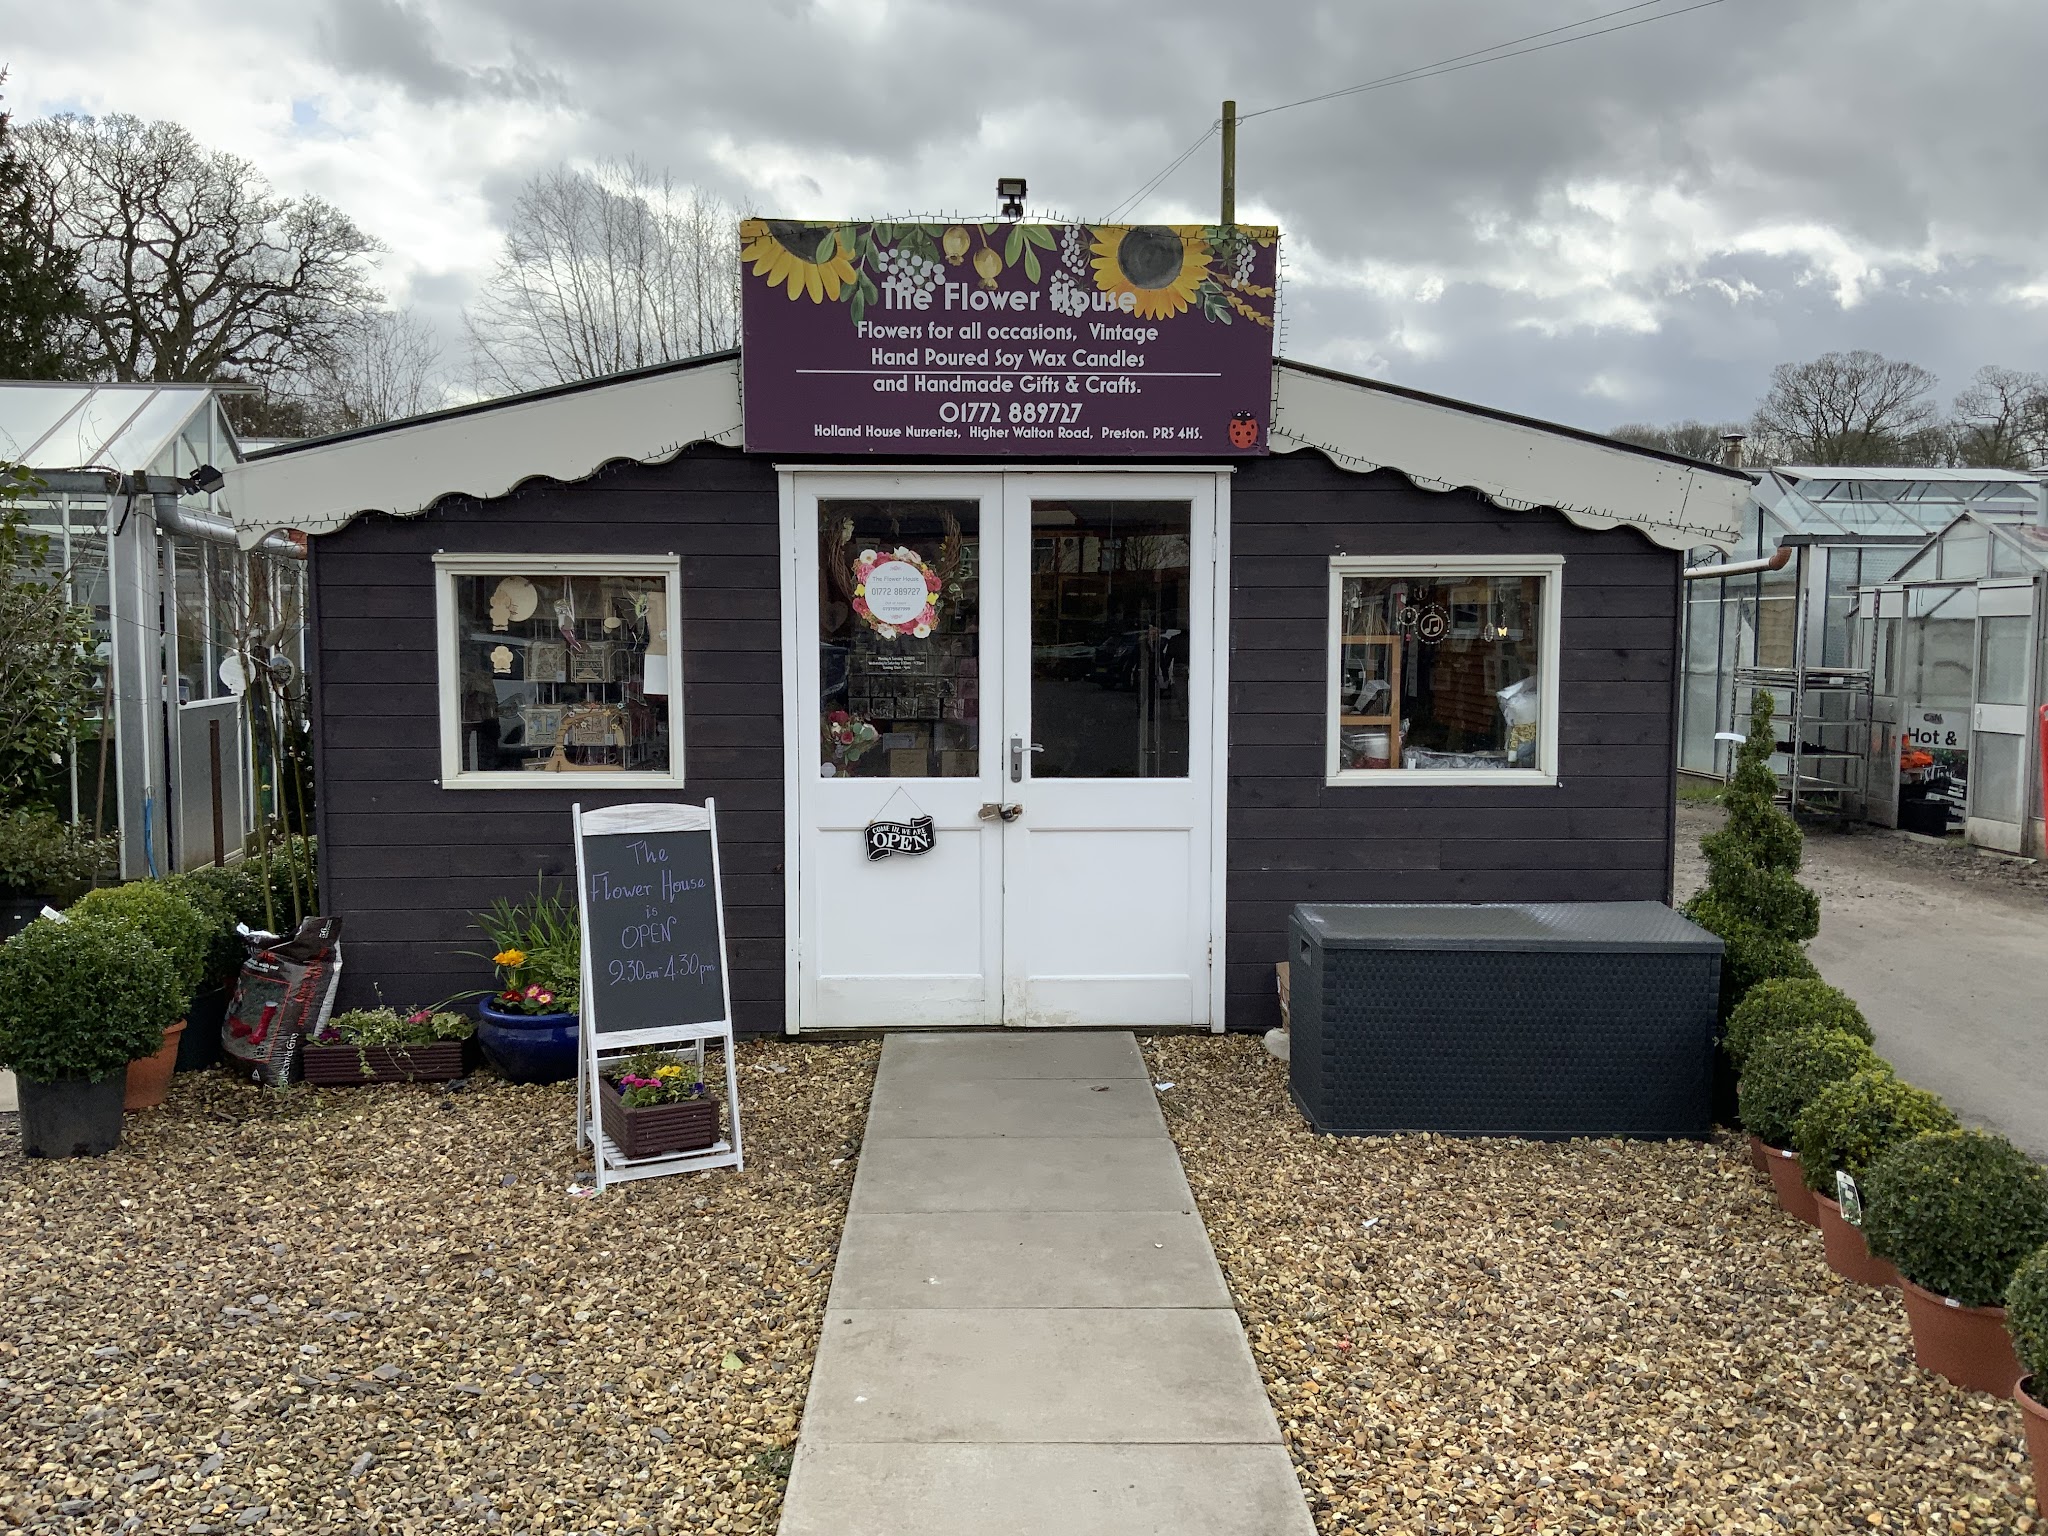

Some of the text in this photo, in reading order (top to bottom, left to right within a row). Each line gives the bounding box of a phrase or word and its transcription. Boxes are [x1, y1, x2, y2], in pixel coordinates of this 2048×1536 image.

[881, 281, 1138, 313] The Flower House
[857, 320, 1159, 345] Flowers for all occasions, Vintage
[871, 347, 1145, 370] Hand Poured Soy Wax Candles
[873, 374, 1142, 394] and Handmade Gifts & Crafts.
[939, 402, 1083, 424] 01772 889727
[814, 424, 1203, 441] Holland House Nurseries, Higher Walton Road, Preston. PR5 4HS.
[871, 587, 892, 596] 01772
[1908, 727, 1957, 746] Hot &
[872, 825, 891, 834] COME
[901, 828, 911, 836] WE
[912, 827, 926, 836] ARE
[872, 832, 929, 851] OPEN
[626, 840, 669, 865] The
[591, 870, 706, 903] Flower House
[645, 904, 658, 919] is
[621, 916, 677, 949] OPEN
